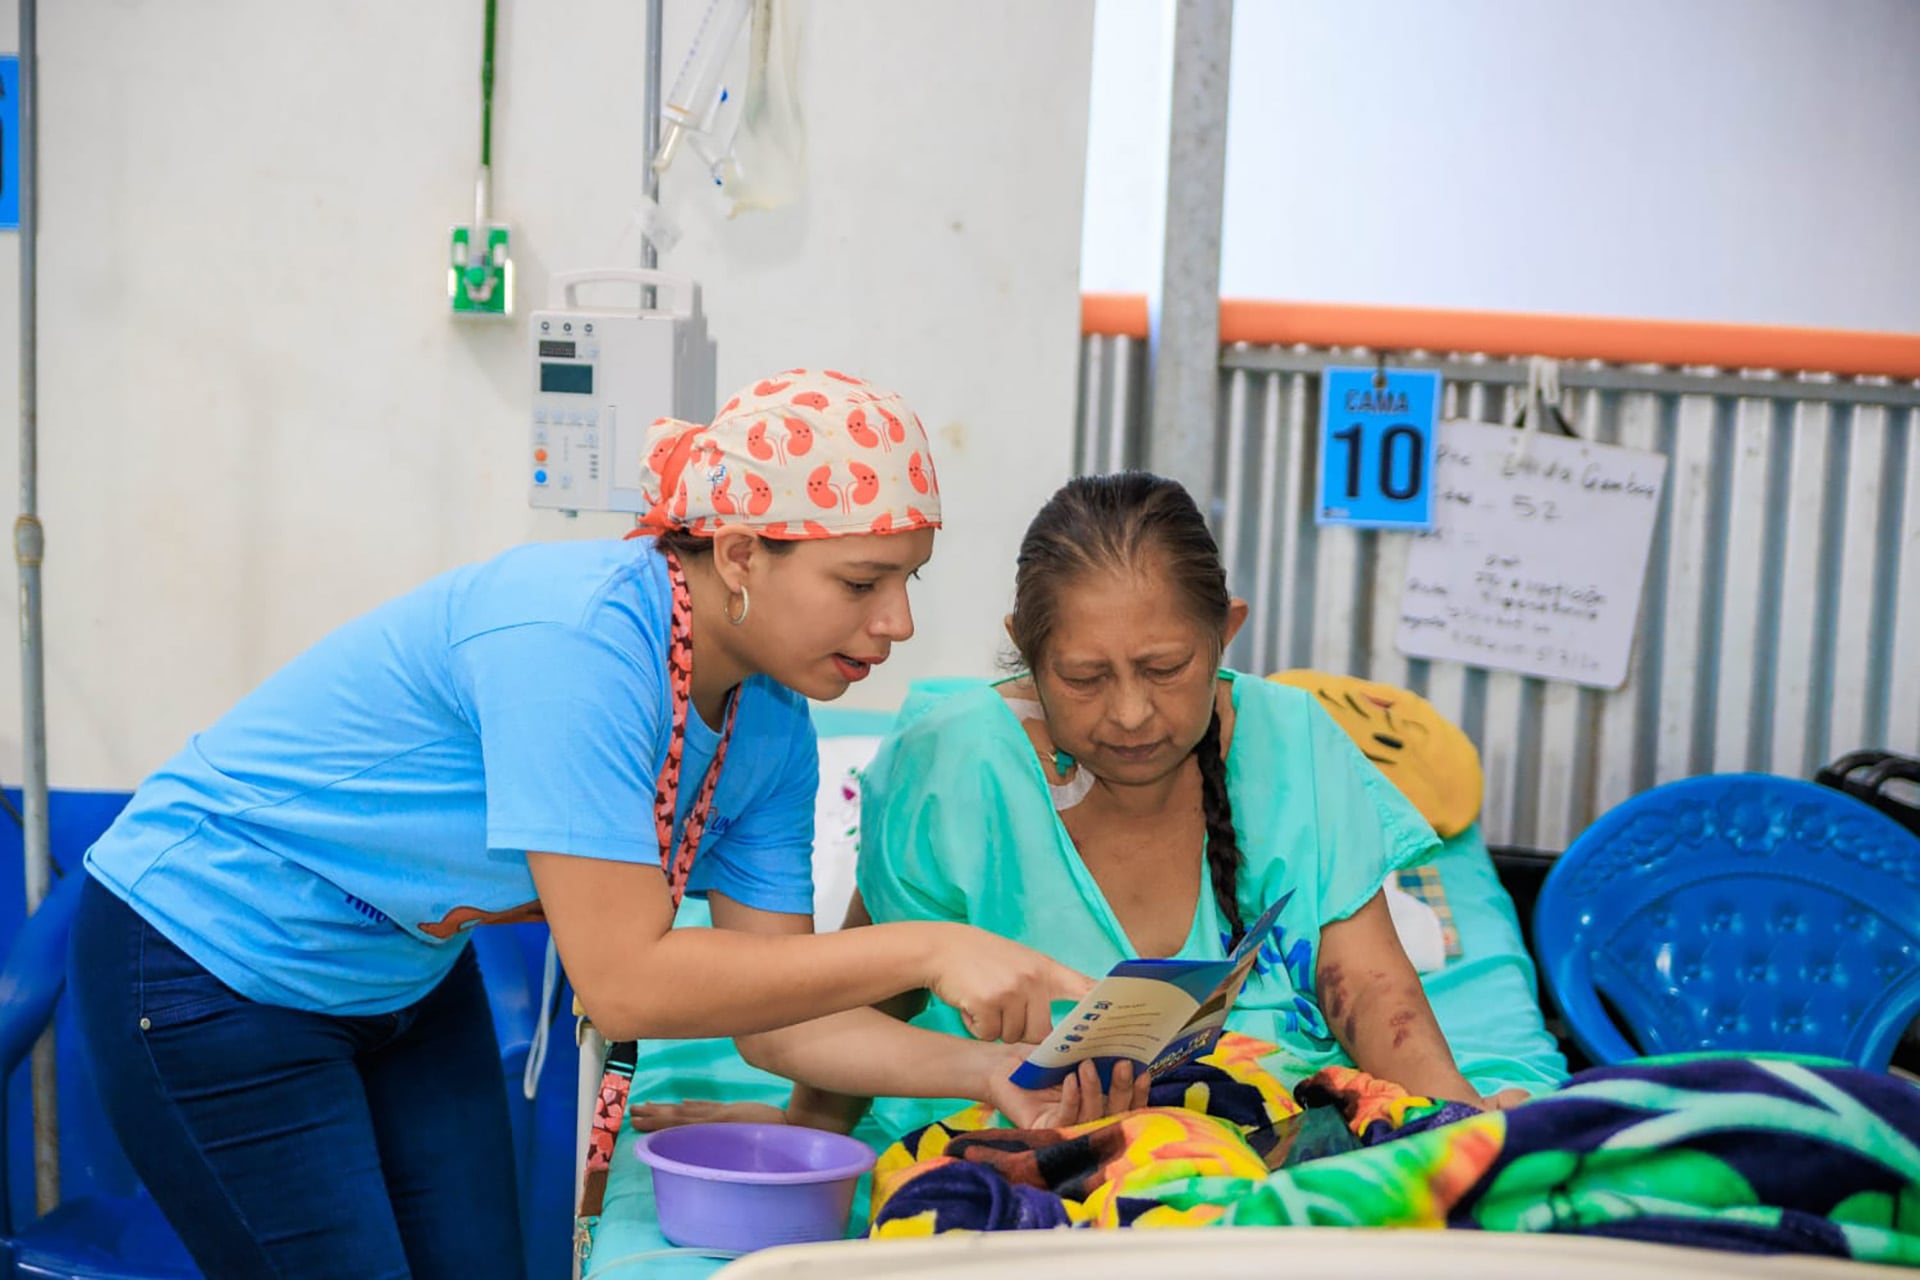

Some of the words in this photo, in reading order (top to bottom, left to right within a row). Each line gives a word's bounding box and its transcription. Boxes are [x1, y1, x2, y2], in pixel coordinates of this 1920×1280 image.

[1346, 389, 1408, 413] CAMA
[1332, 422, 1424, 501] 10
[1513, 494, 1559, 520] 52
